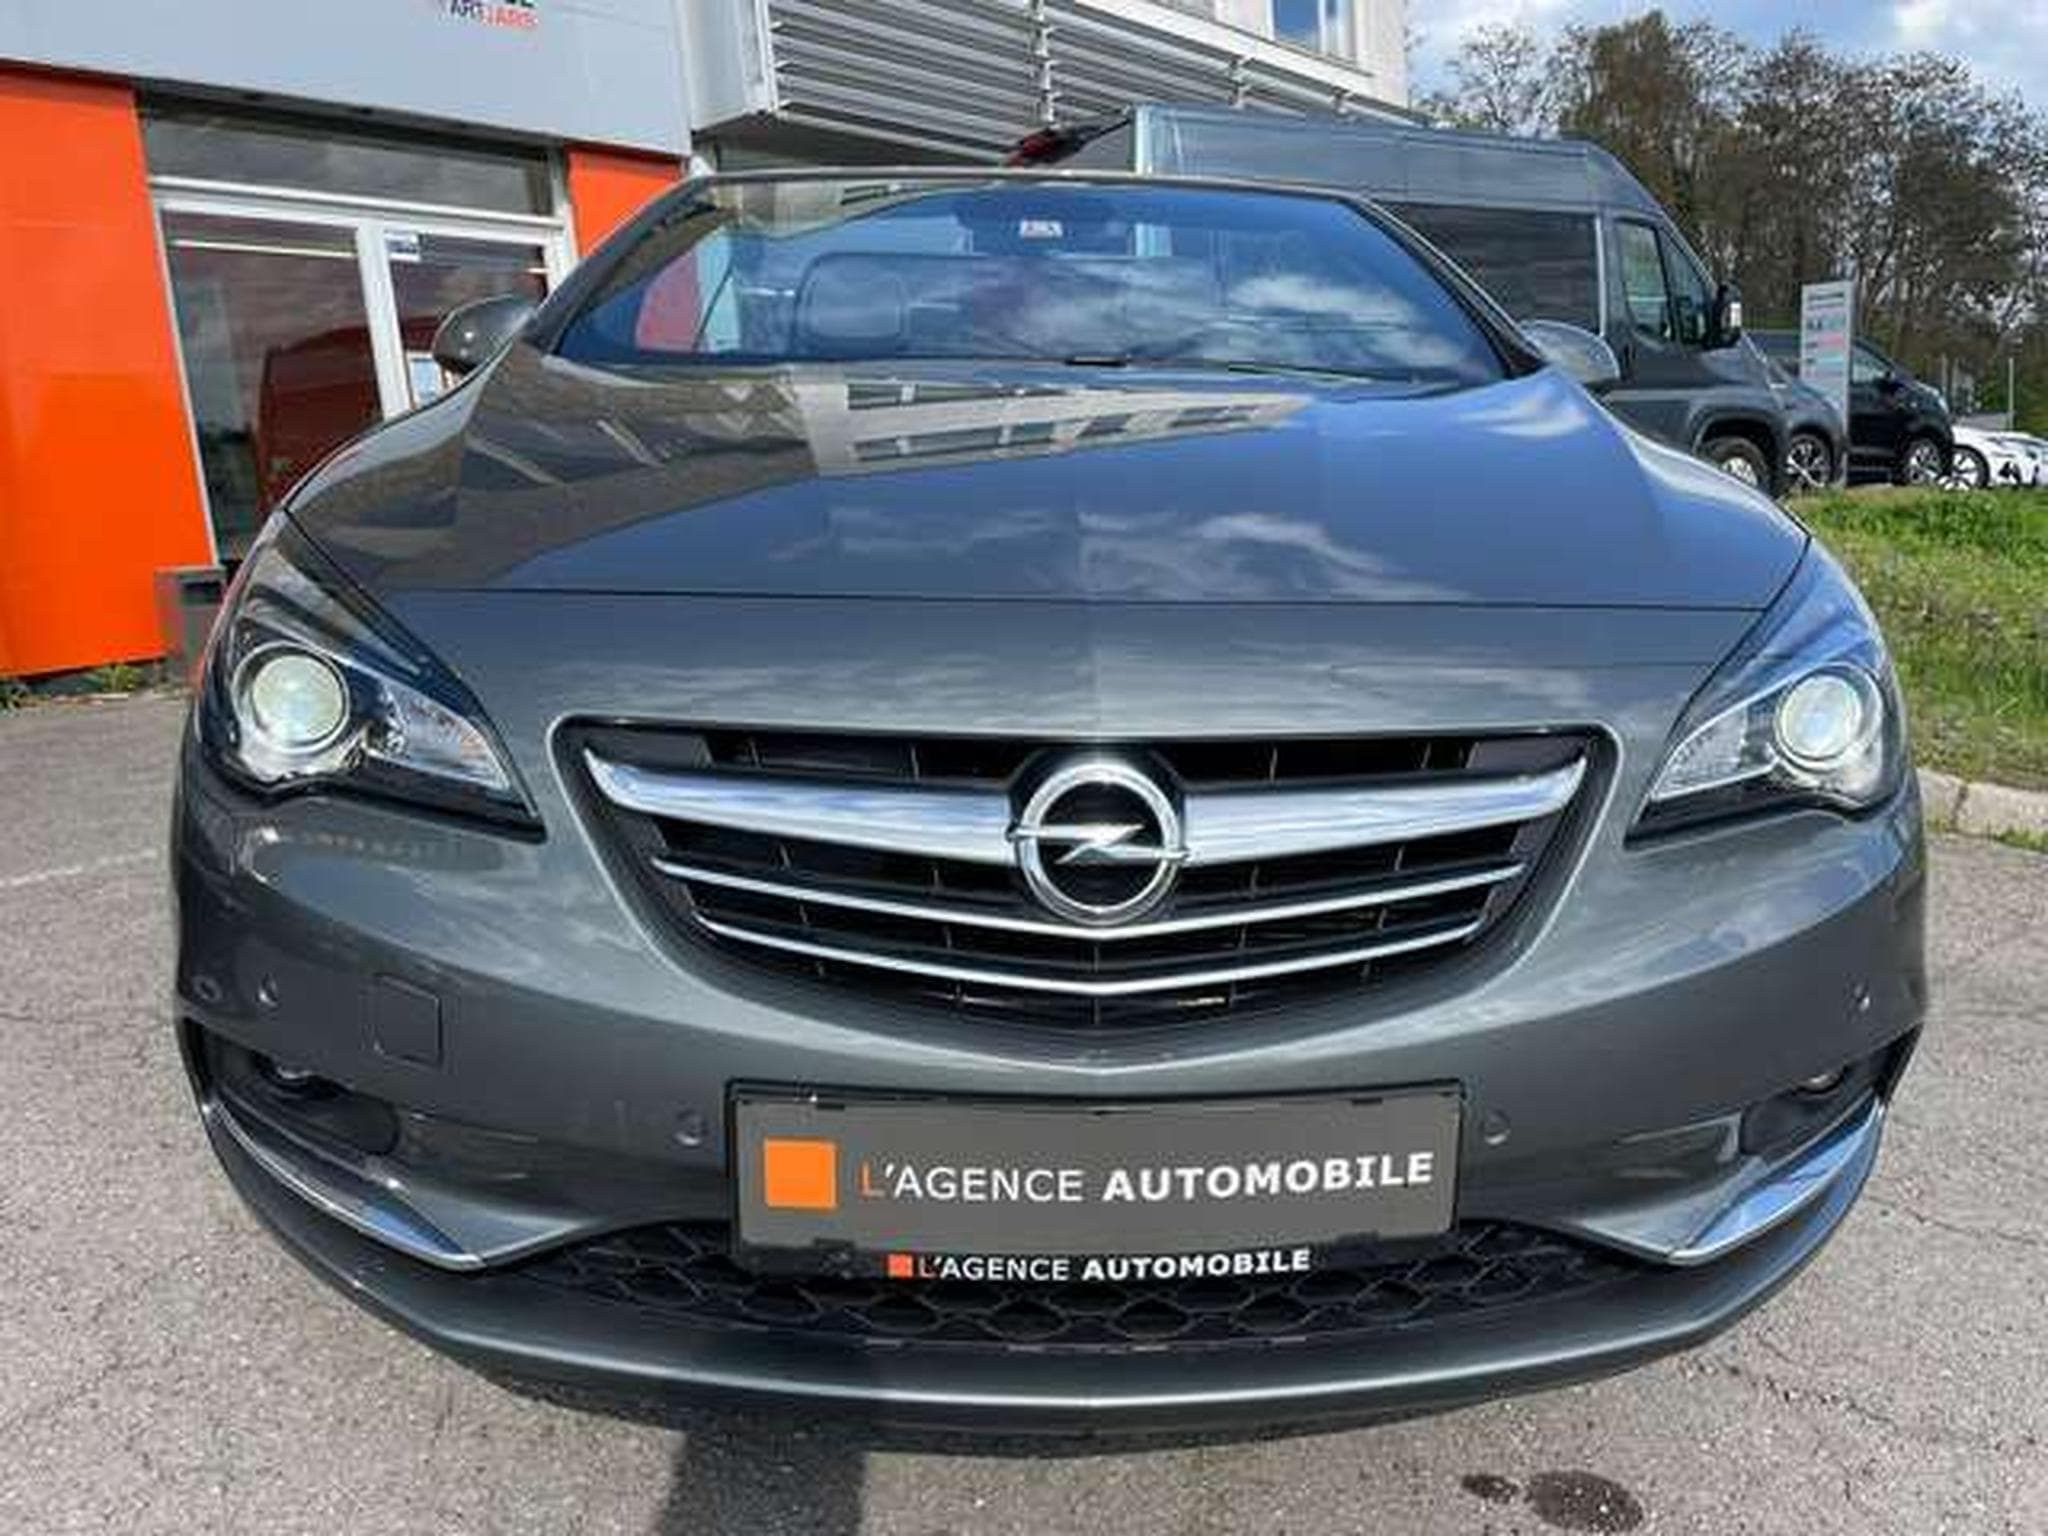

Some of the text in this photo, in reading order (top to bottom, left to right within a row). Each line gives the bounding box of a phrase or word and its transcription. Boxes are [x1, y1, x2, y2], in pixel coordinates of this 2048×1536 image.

[860, 1151, 1435, 1202] L'AGENCE AUTOMOBILE
[918, 1249, 1311, 1283] L'AGENCE AUTOMOBILE
